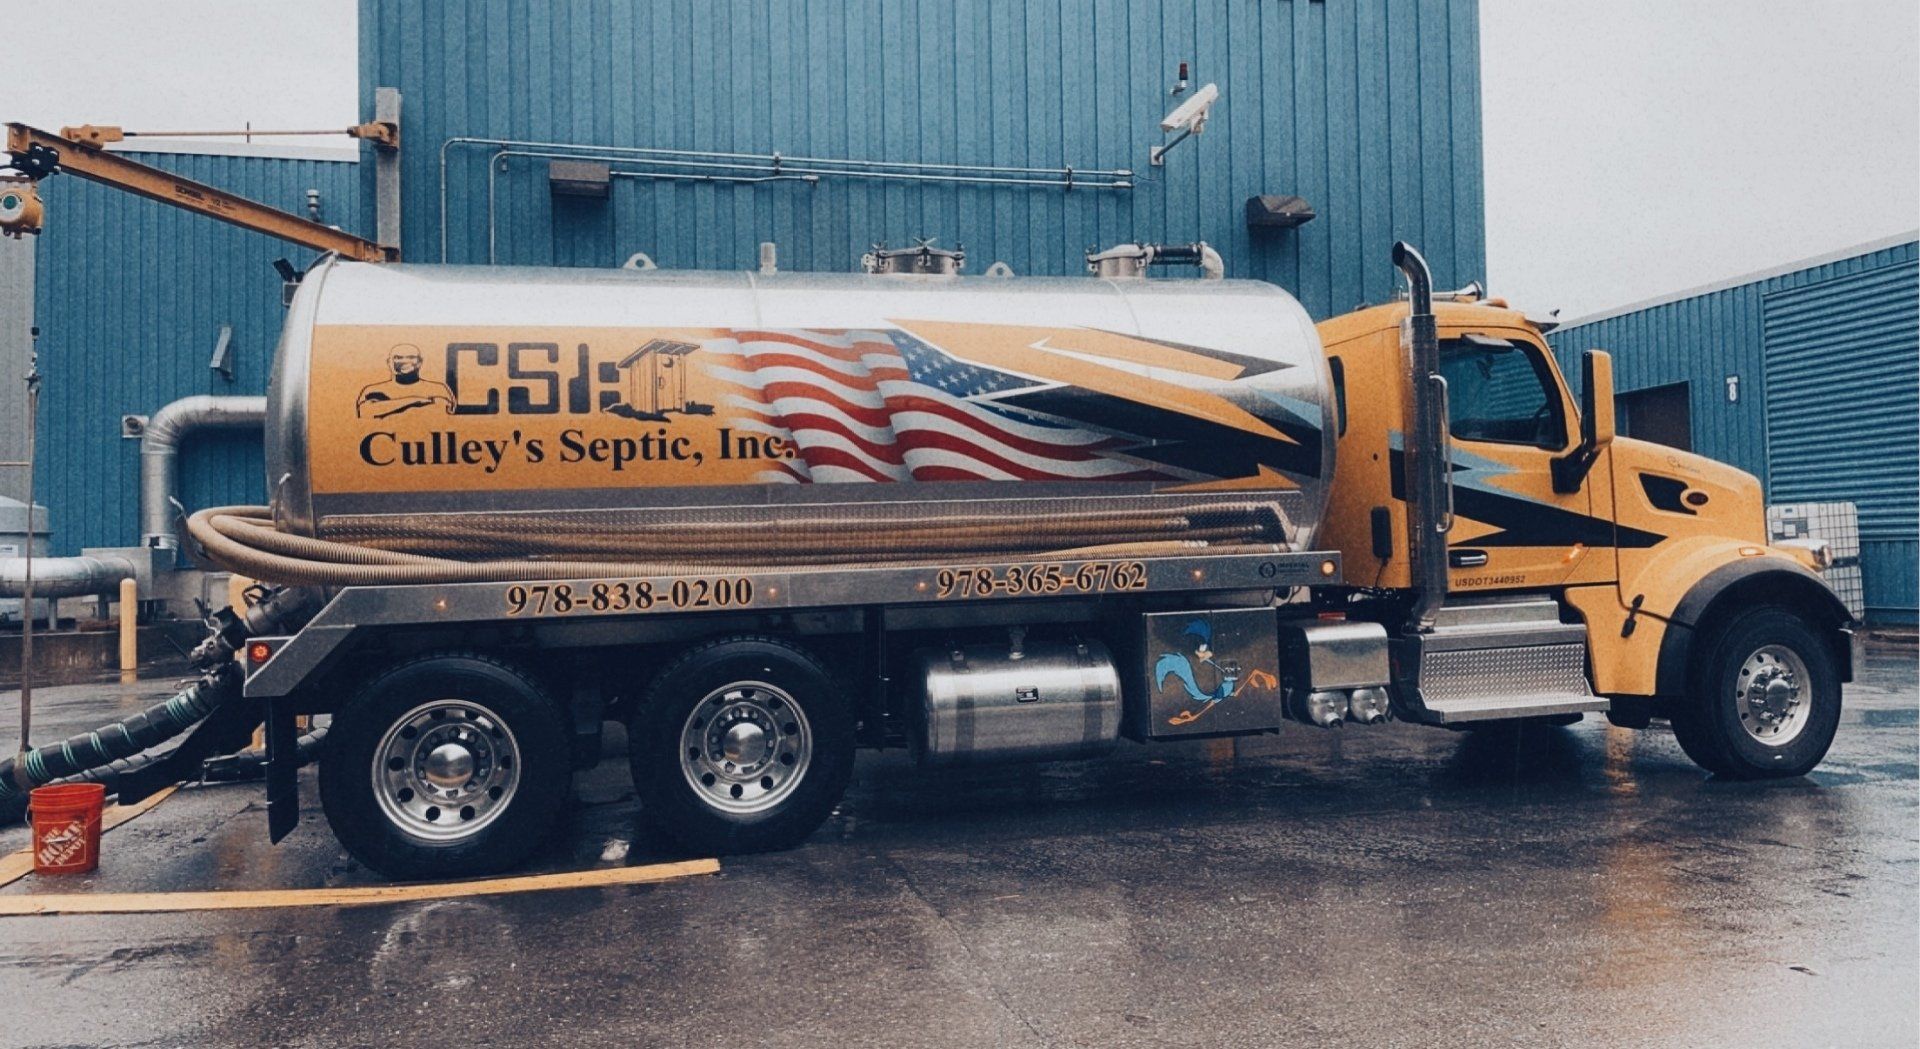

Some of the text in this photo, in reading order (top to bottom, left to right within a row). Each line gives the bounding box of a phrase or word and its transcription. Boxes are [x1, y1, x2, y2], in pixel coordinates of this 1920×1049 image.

[359, 427, 796, 473] Culley's Septic, Inc.
[507, 578, 752, 615] 978-838-0200
[937, 562, 1147, 597] 978-365-6762
[1455, 575, 1525, 587] USDOT3440952
